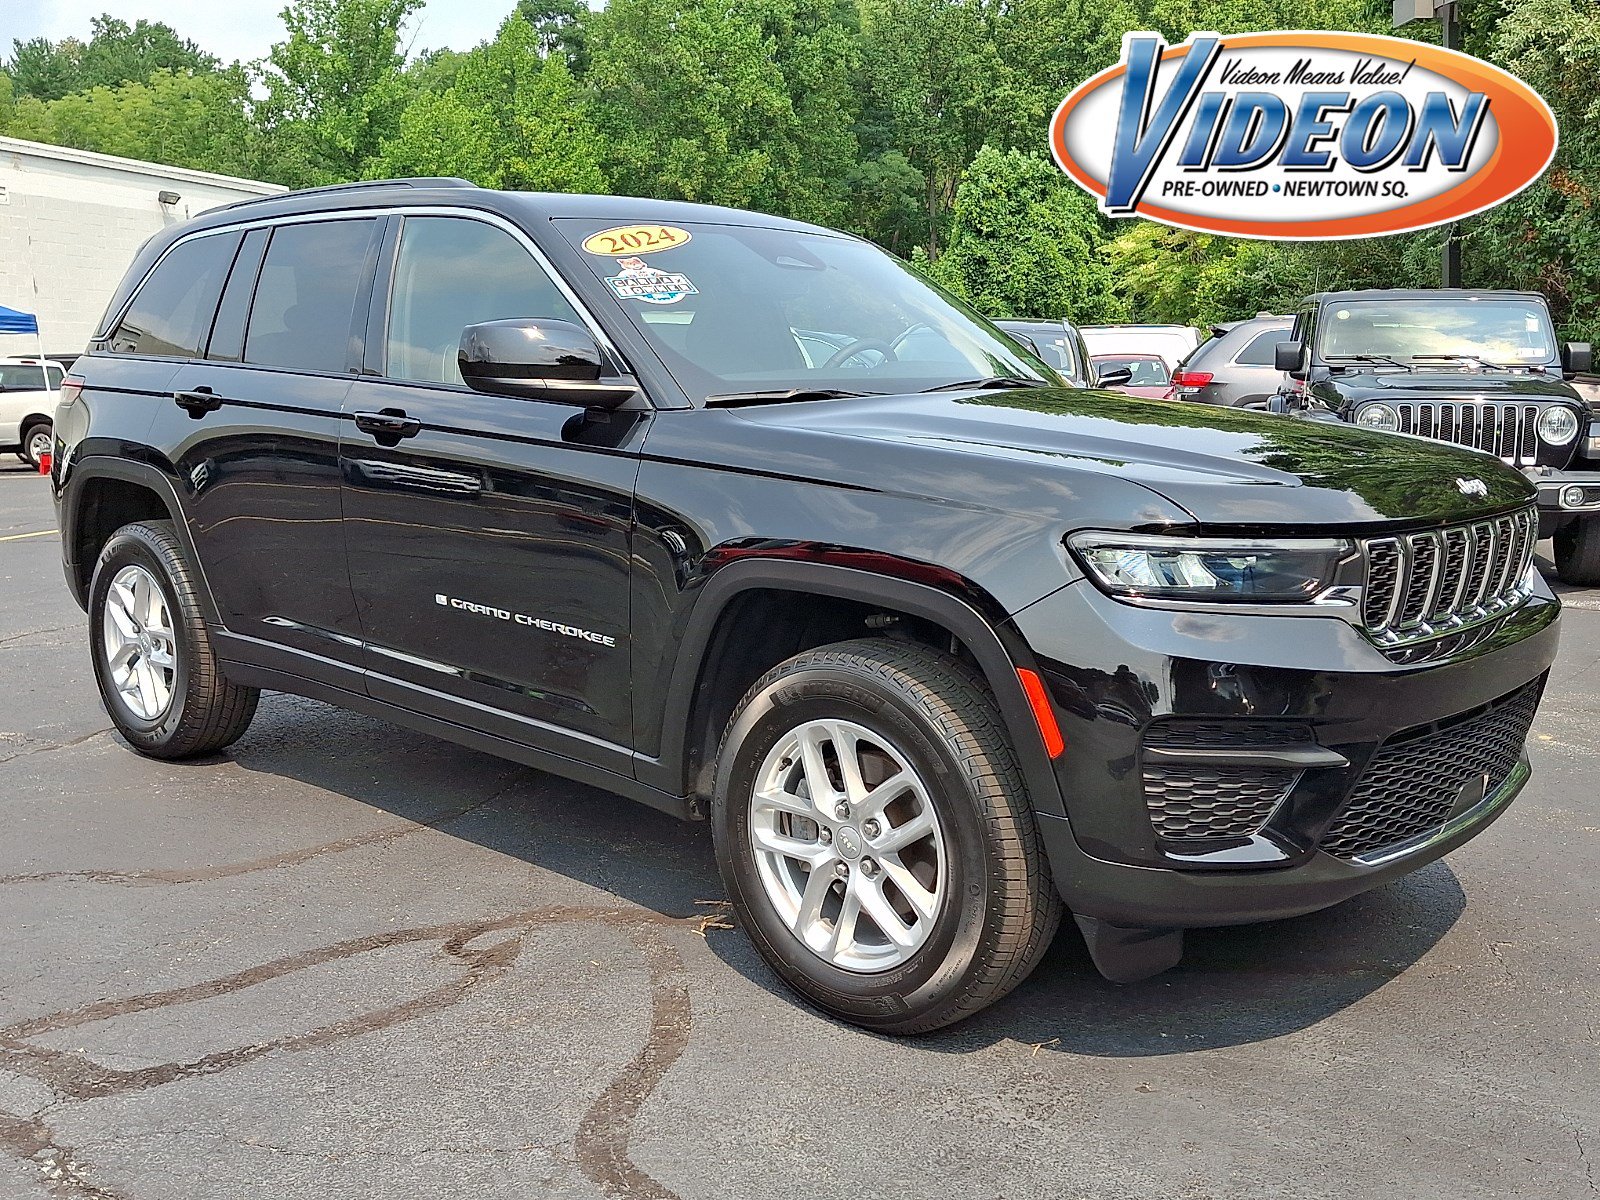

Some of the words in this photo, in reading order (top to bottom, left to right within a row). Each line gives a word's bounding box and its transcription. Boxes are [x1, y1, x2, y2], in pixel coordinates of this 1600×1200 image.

[600, 228, 676, 253] 2024
[450, 598, 511, 621] GRAND
[514, 613, 616, 648] CHEROKEE
